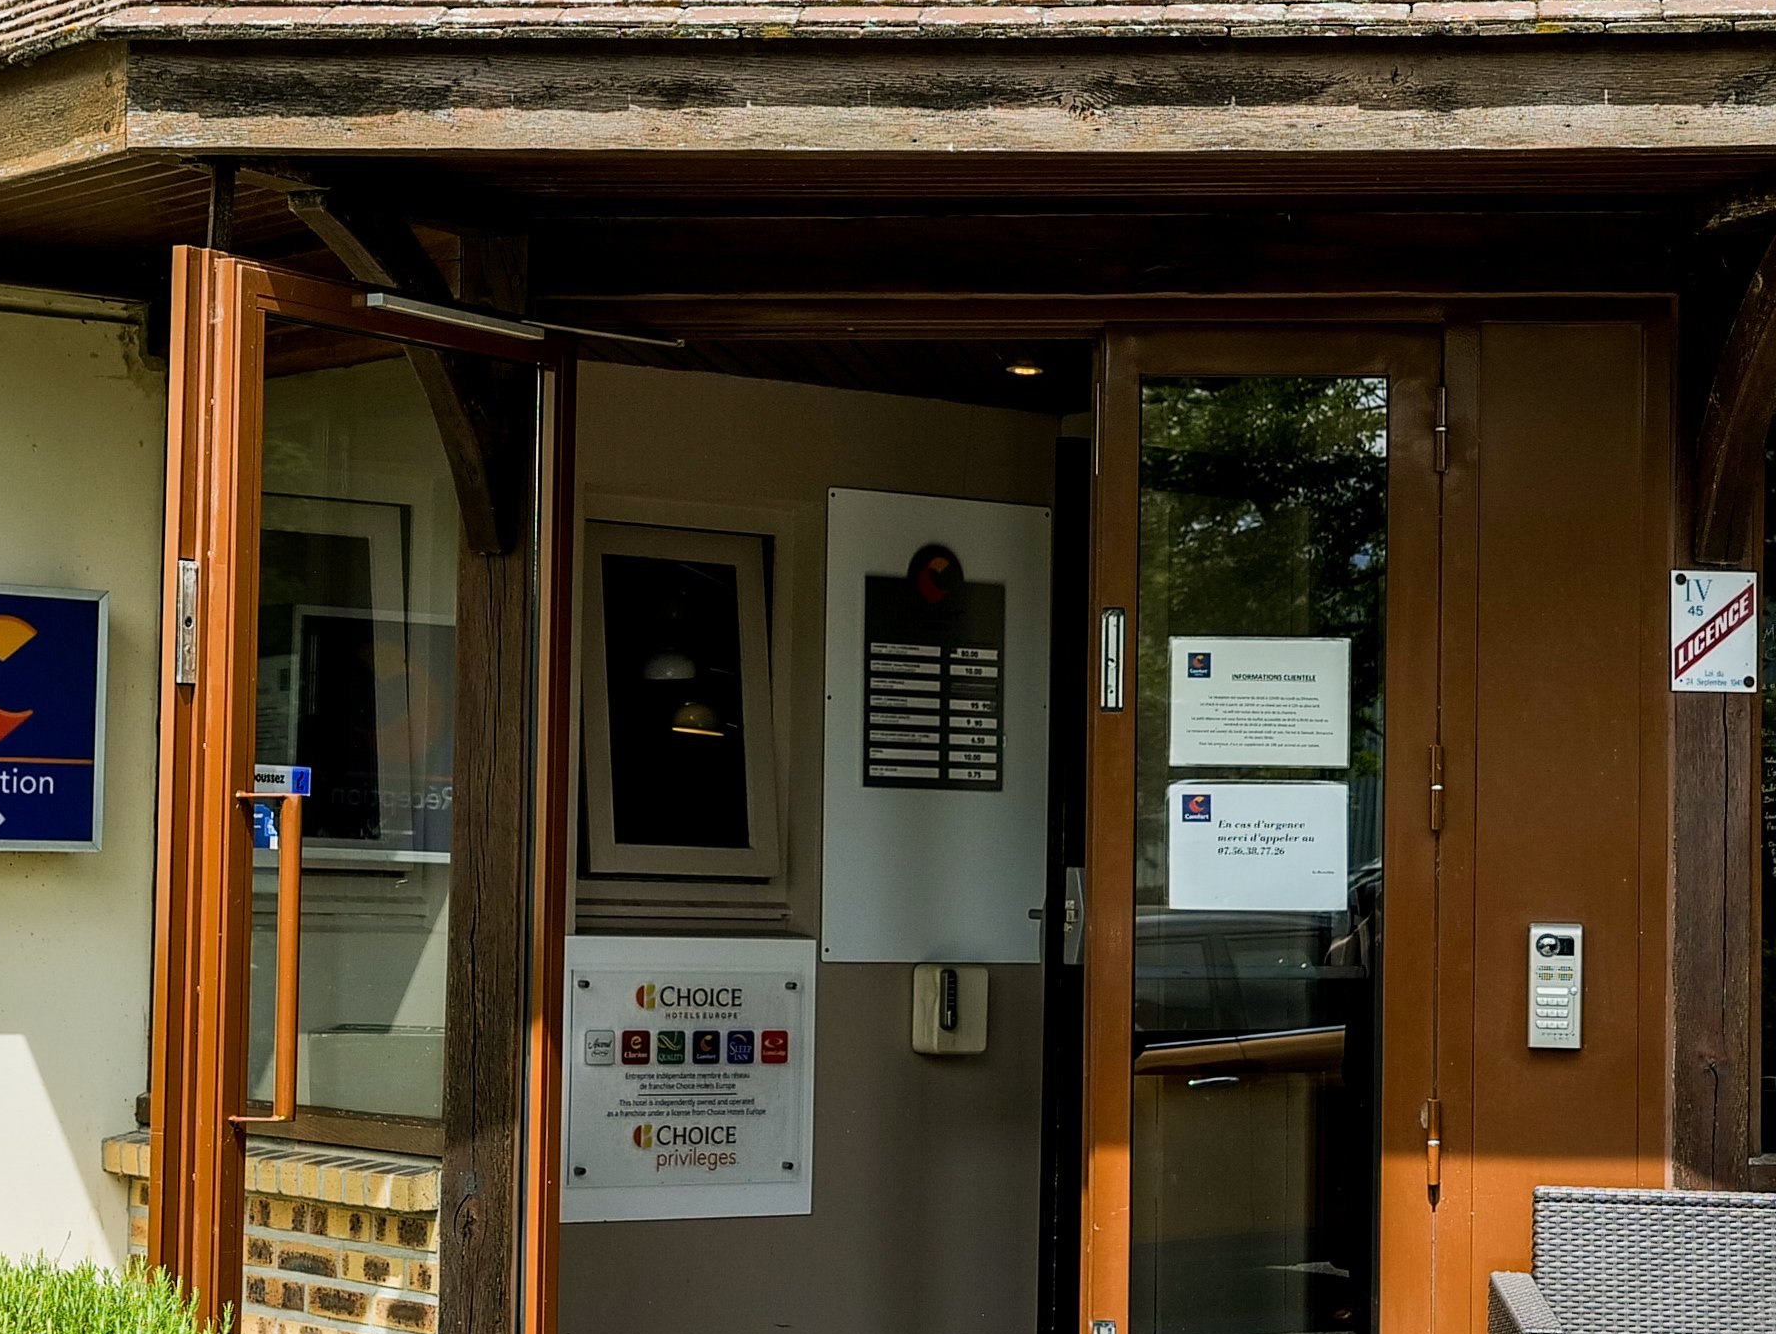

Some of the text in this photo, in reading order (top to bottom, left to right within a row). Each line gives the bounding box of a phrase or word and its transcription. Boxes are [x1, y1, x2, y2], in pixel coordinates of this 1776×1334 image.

[1685, 579, 1713, 602] IV
[1688, 605, 1704, 616] 45
[1678, 593, 1749, 670] LICENCE
[1232, 673, 1316, 682] INFORMATIONS CLIENTELE
[254, 773, 285, 784] oussez
[1218, 819, 1305, 831] En cas d'urgence
[1217, 833, 1247, 842] merci
[1250, 833, 1299, 845] d'appeler
[660, 986, 742, 1007] CHOICE
[665, 1012, 700, 1020] HOTELS
[729, 1042, 752, 1056] SLEEP
[625, 1073, 655, 1081] Entreprise
[715, 1082, 736, 1090] Europe
[654, 1099, 695, 1108] independently
[657, 1126, 736, 1145] CHOICE
[656, 1148, 736, 1172] privileges
